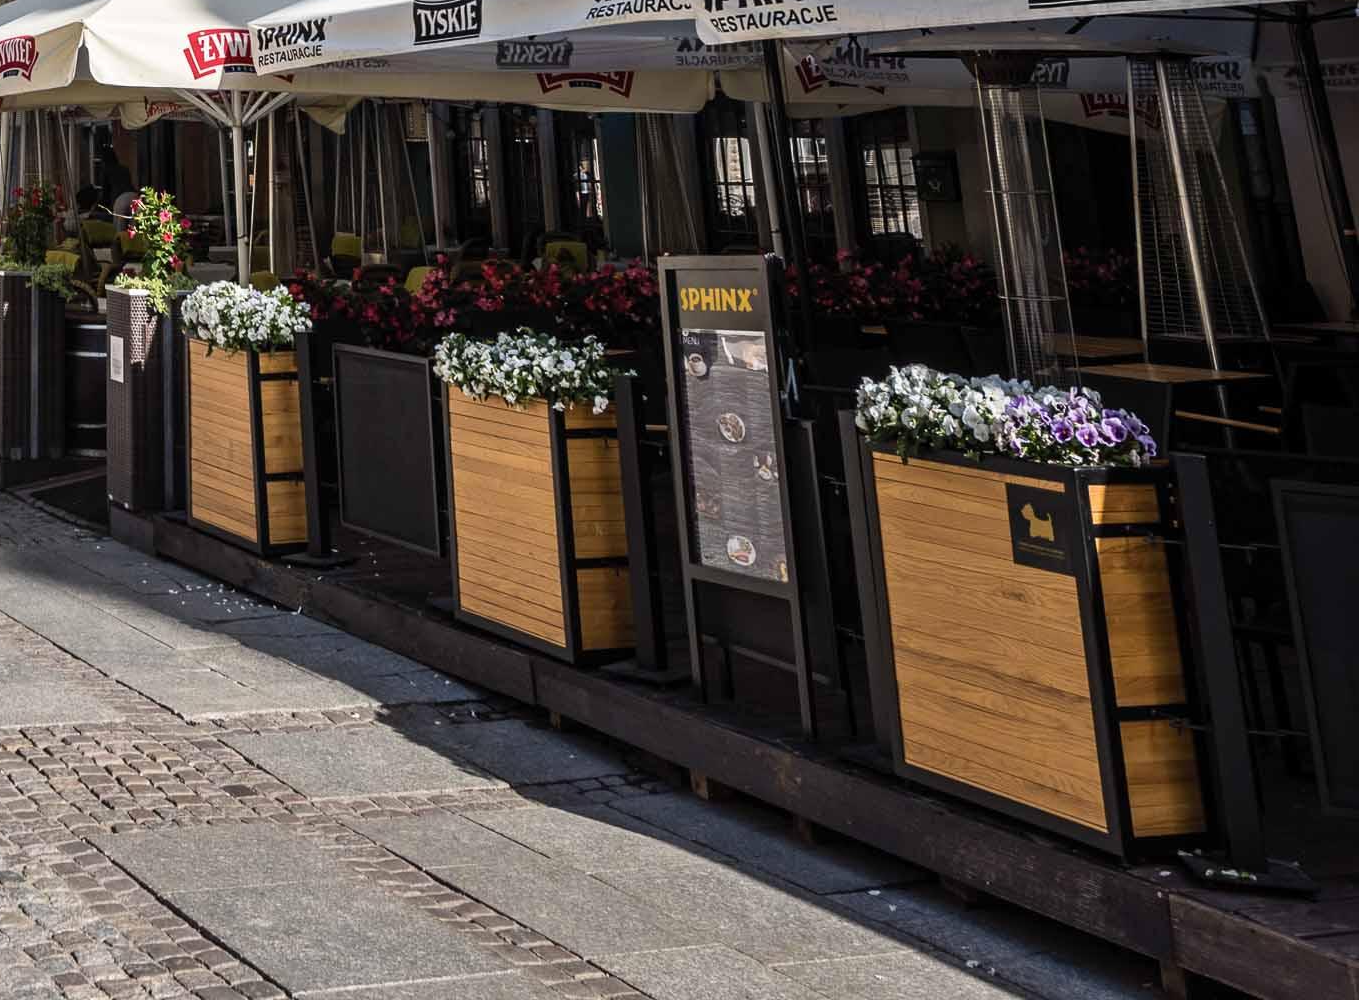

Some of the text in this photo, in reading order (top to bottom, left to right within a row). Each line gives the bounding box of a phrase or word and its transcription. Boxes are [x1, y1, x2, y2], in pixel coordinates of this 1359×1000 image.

[417, 1, 479, 37] TYSKIE
[710, 4, 837, 33] RESTAURACJE
[198, 32, 250, 63] ŻYW
[259, 45, 323, 67] RESTAURACJE
[681, 287, 753, 312] SPHINX
